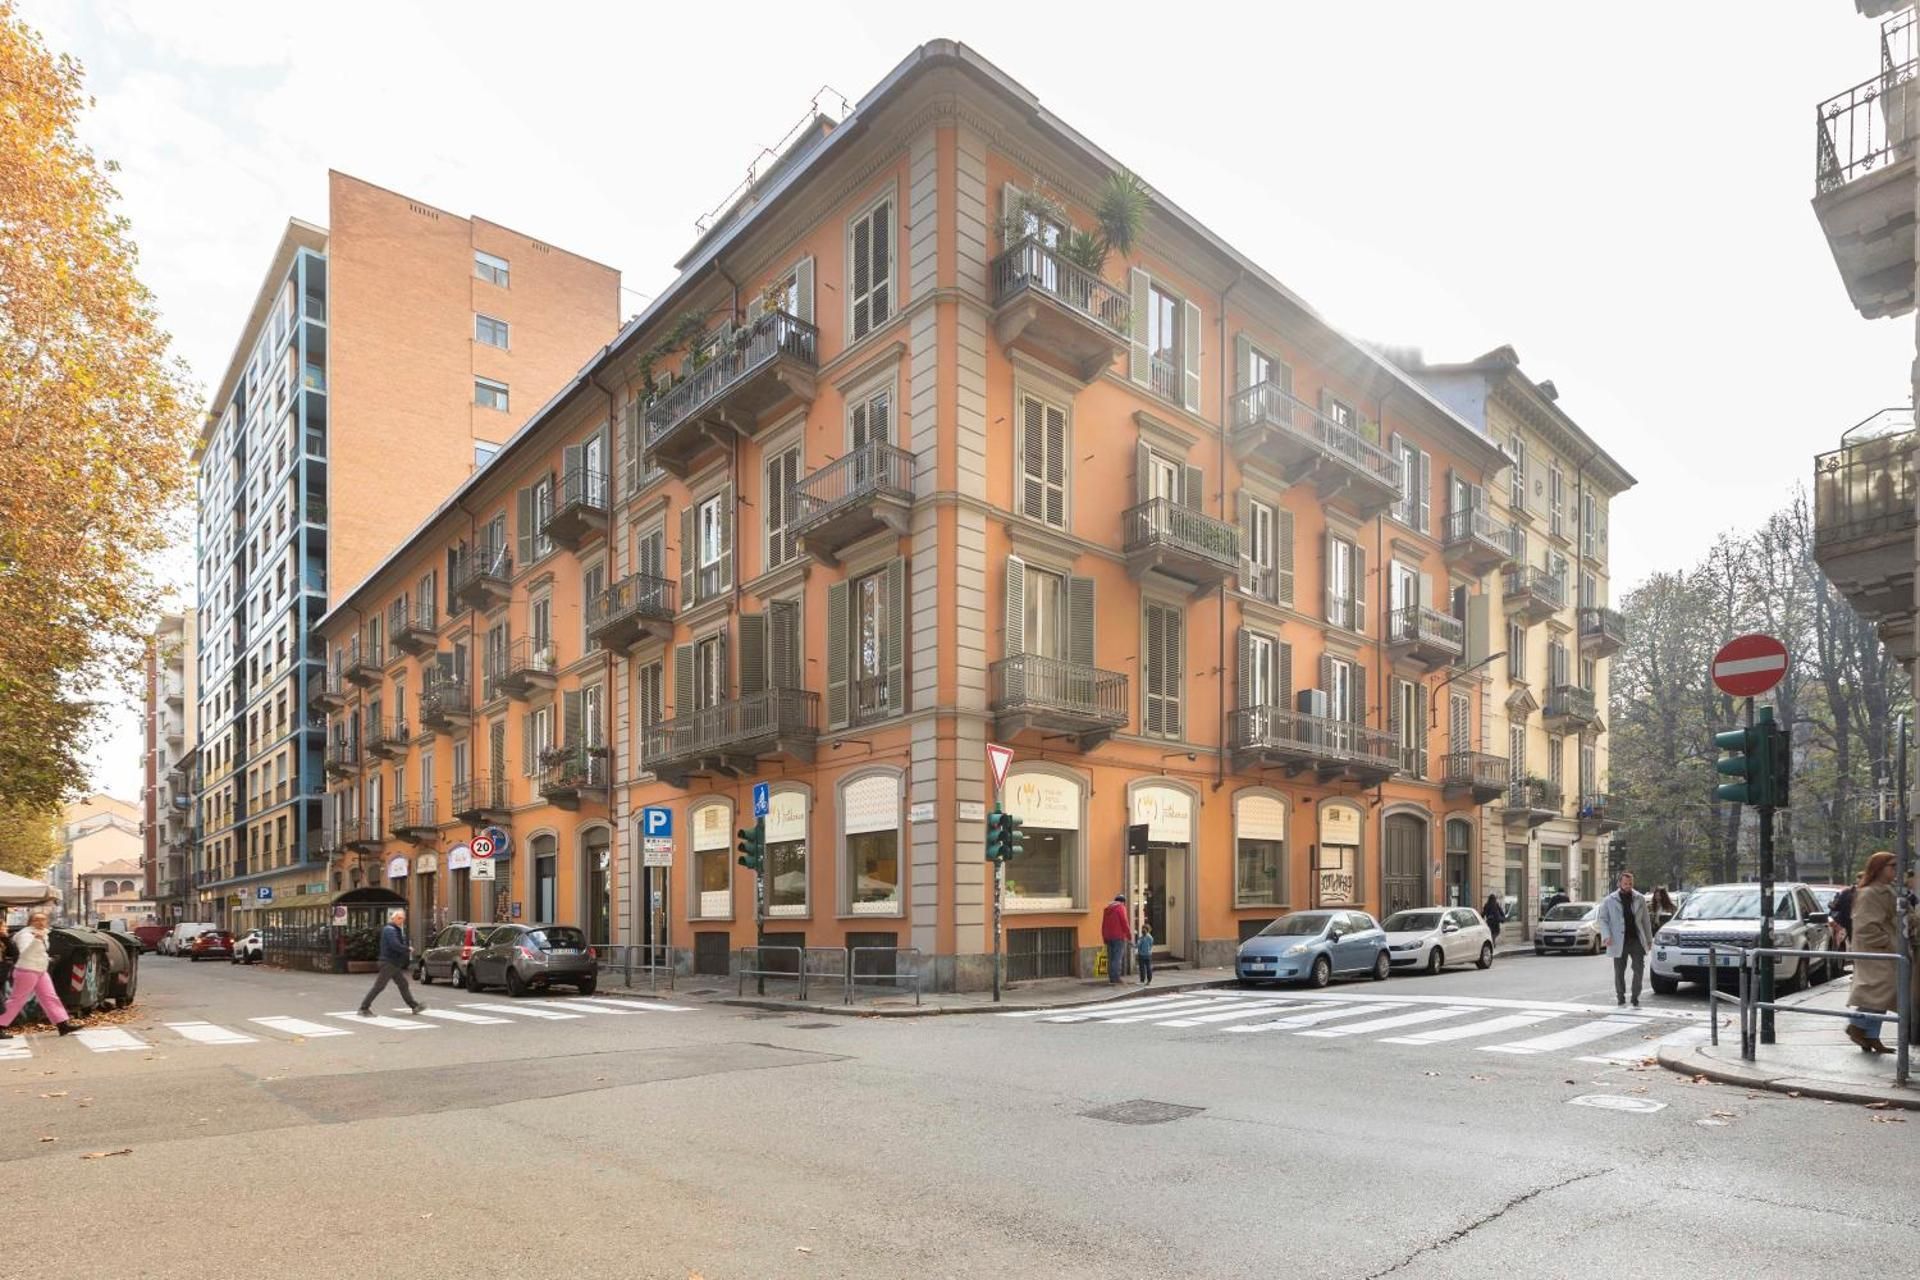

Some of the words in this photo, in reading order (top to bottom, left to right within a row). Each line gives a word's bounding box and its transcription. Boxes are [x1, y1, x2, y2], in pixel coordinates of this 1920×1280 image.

[649, 811, 667, 833] P
[476, 842, 489, 851] 20
[260, 888, 269, 897] P
